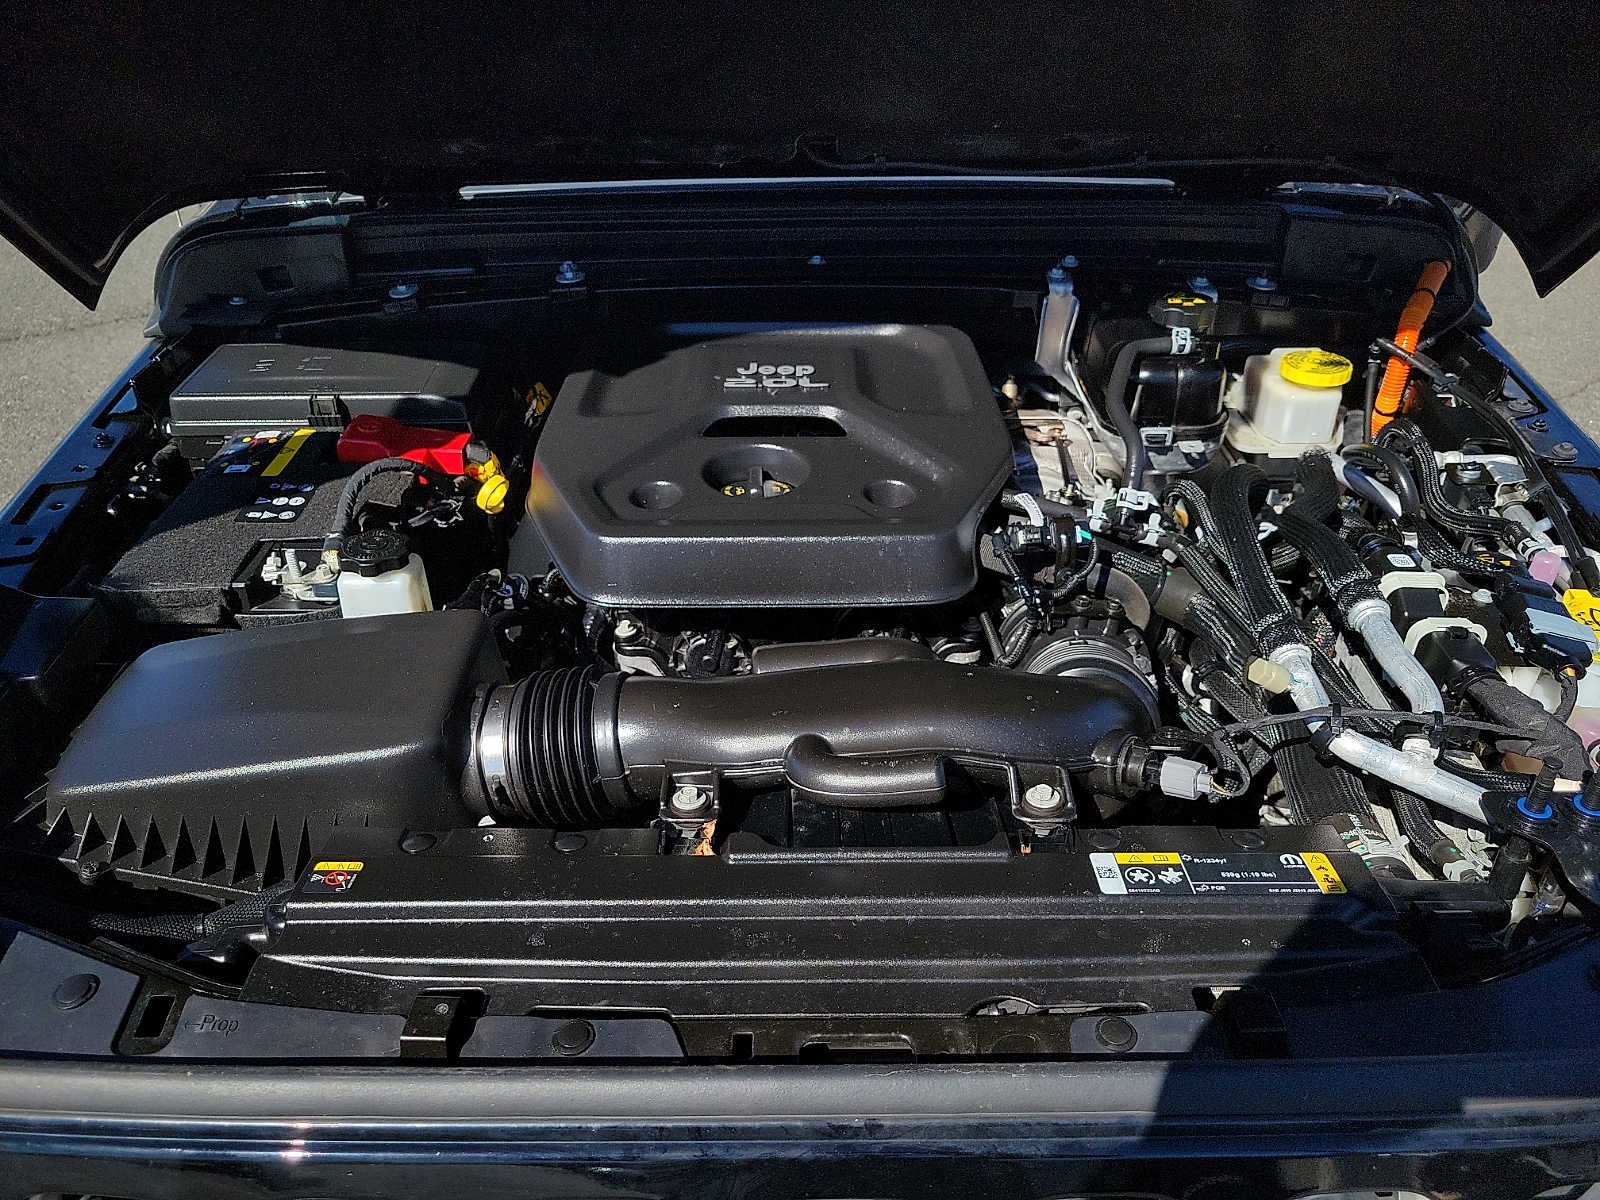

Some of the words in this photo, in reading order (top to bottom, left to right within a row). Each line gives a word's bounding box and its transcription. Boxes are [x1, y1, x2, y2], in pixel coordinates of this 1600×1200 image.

[736, 361, 815, 377] Jeep
[723, 376, 830, 389] 2.0L
[200, 1014, 239, 1038] Prop
